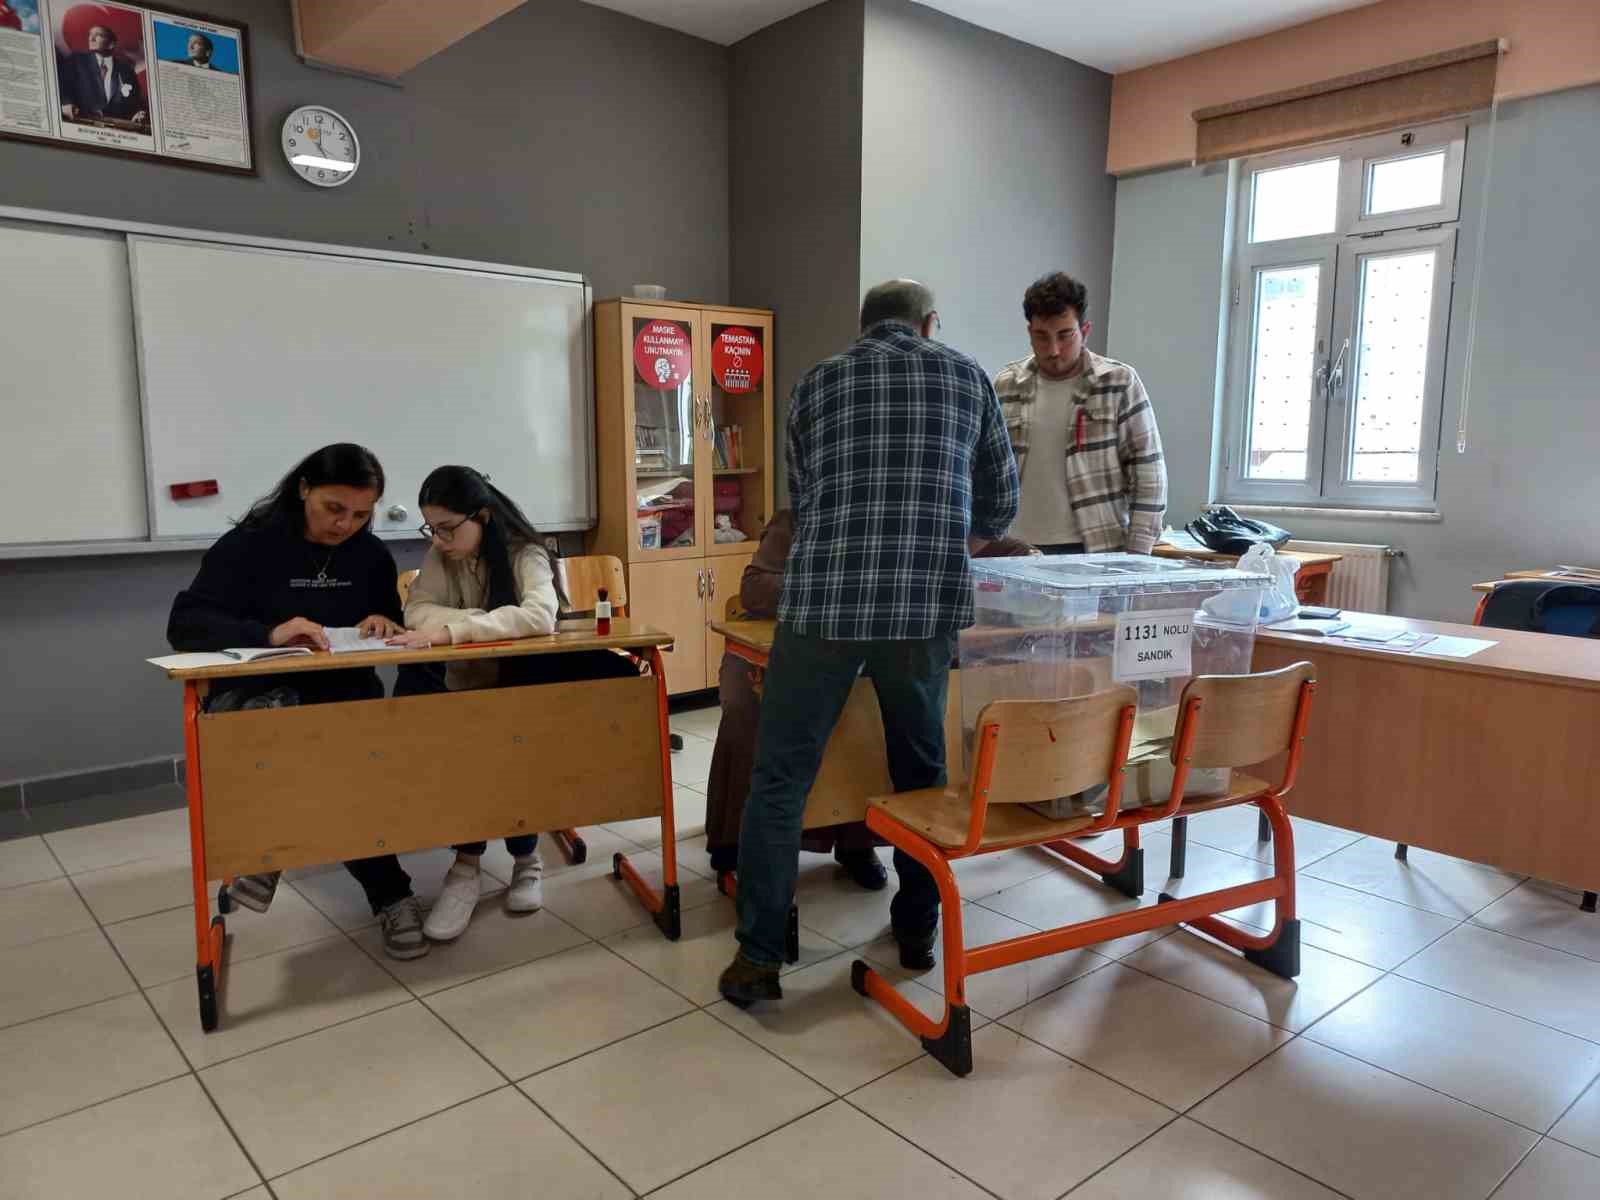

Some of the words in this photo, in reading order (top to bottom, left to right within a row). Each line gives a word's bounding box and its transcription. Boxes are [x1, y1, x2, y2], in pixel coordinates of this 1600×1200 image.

[288, 138, 296, 147] 9
[652, 325, 676, 335] MASKE
[643, 335, 684, 346] KULLANMAYI
[721, 333, 755, 345] TEMASTAN
[1125, 624, 1157, 641] 1131
[1163, 624, 1189, 636] NOLU
[1137, 649, 1173, 662] SANDIK
